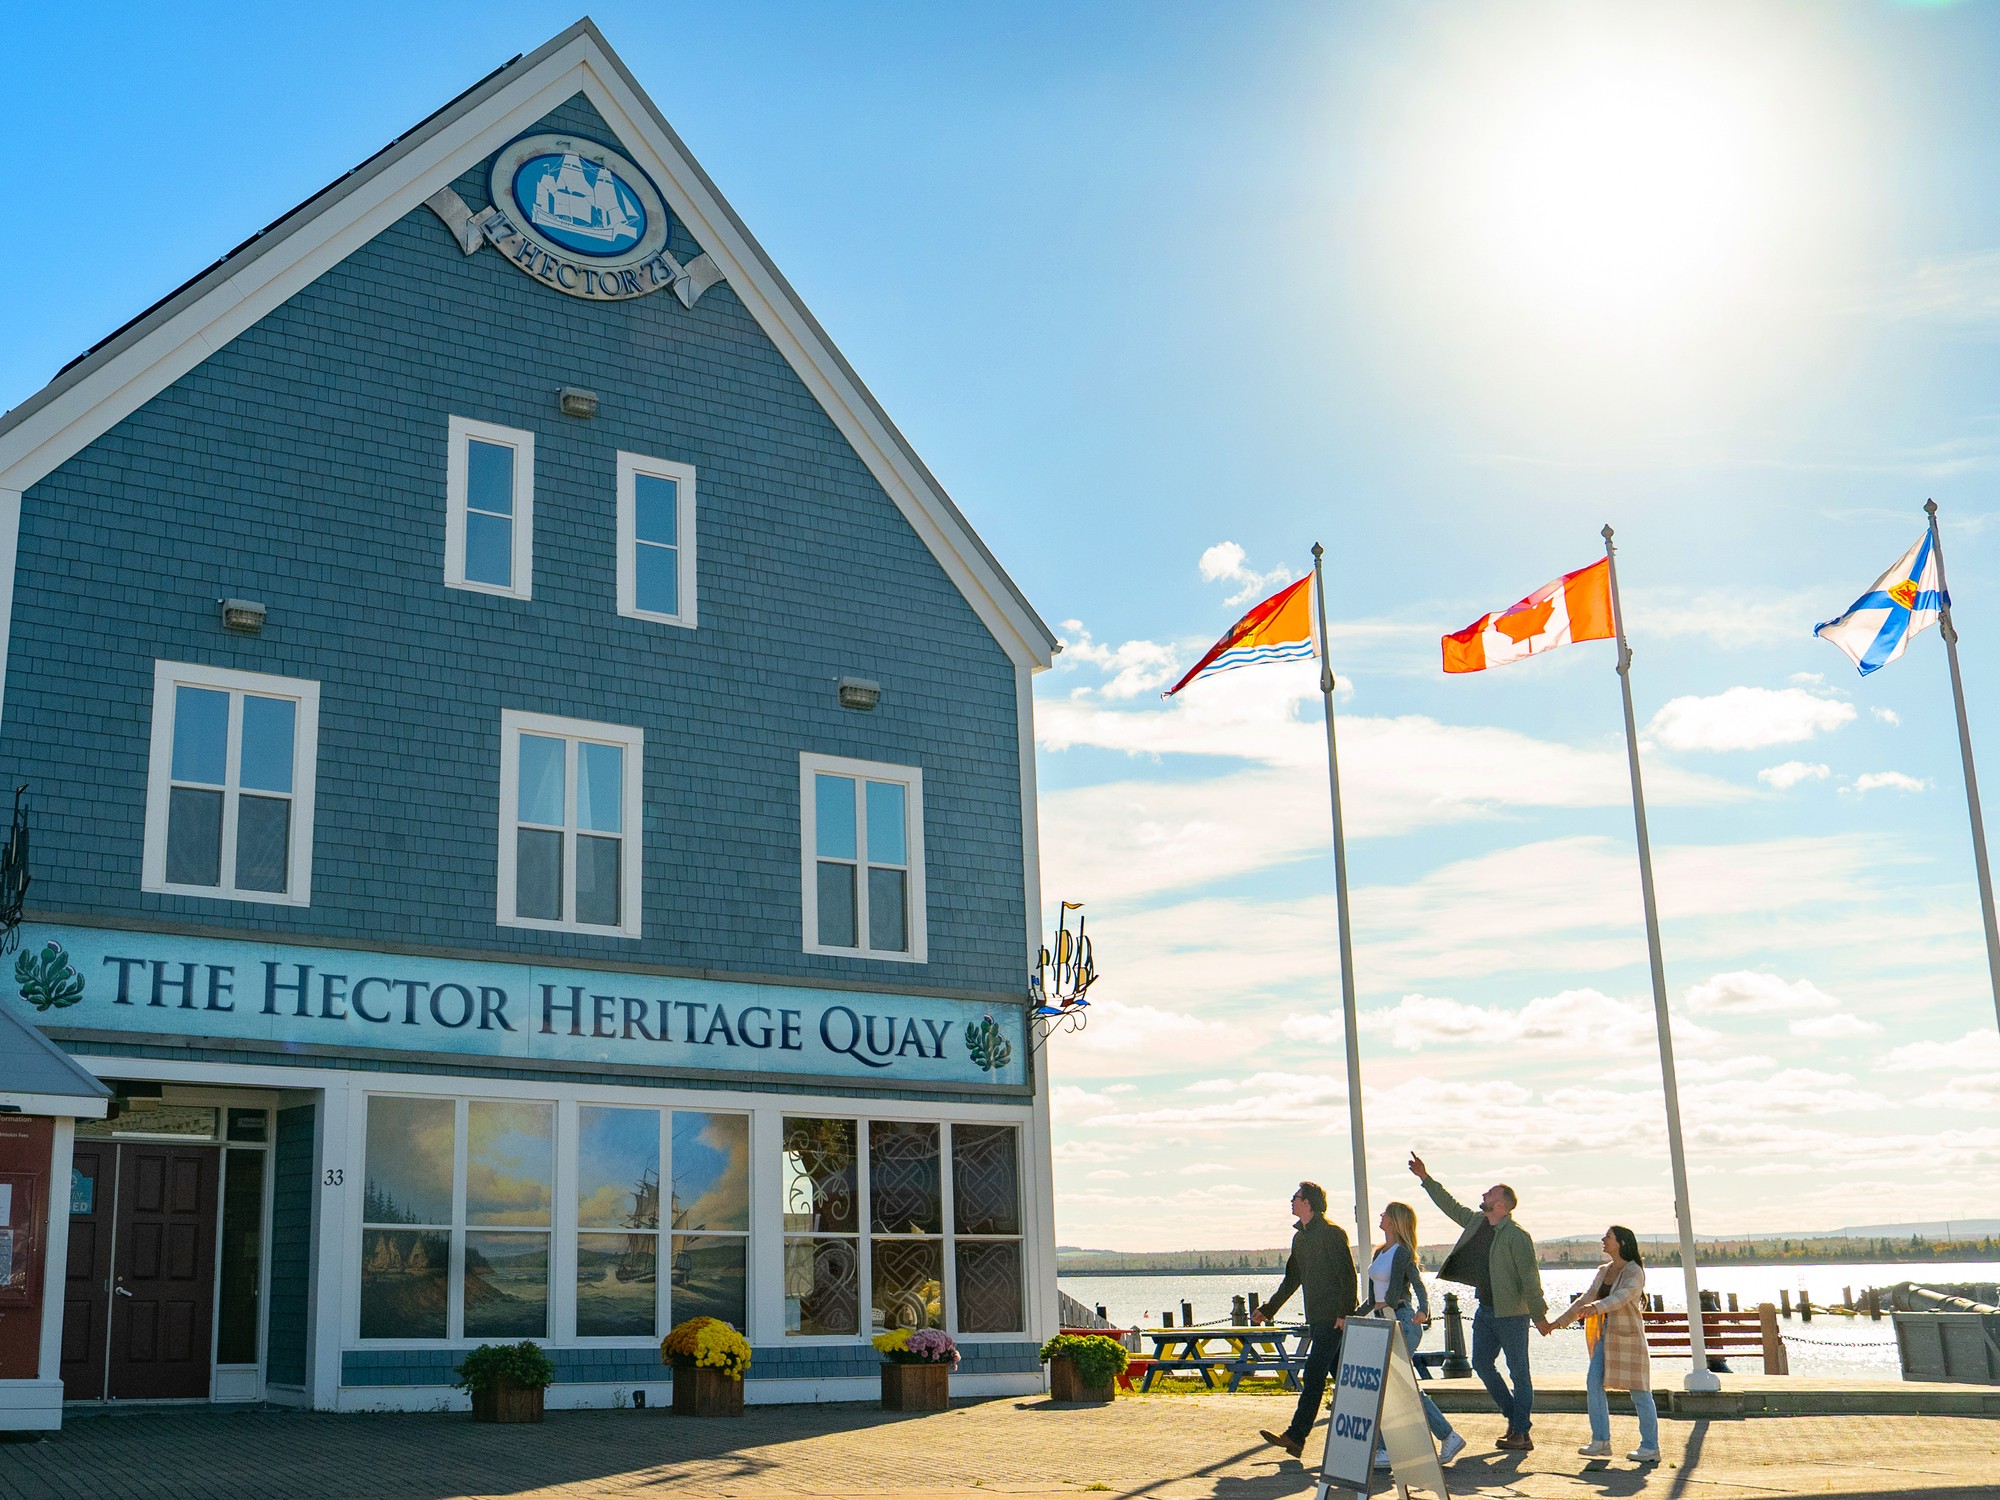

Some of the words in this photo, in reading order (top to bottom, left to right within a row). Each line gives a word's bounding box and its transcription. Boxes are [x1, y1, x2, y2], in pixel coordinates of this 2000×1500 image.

[513, 238, 645, 297] HECTOR
[103, 955, 236, 1012] THE
[259, 960, 517, 1032] HECTOR
[537, 983, 802, 1051] HERITAGE
[819, 1005, 954, 1067] QUAY
[323, 1168, 344, 1186] 33
[1340, 1363, 1381, 1392] BUSES
[1335, 1412, 1372, 1442] ONLY
